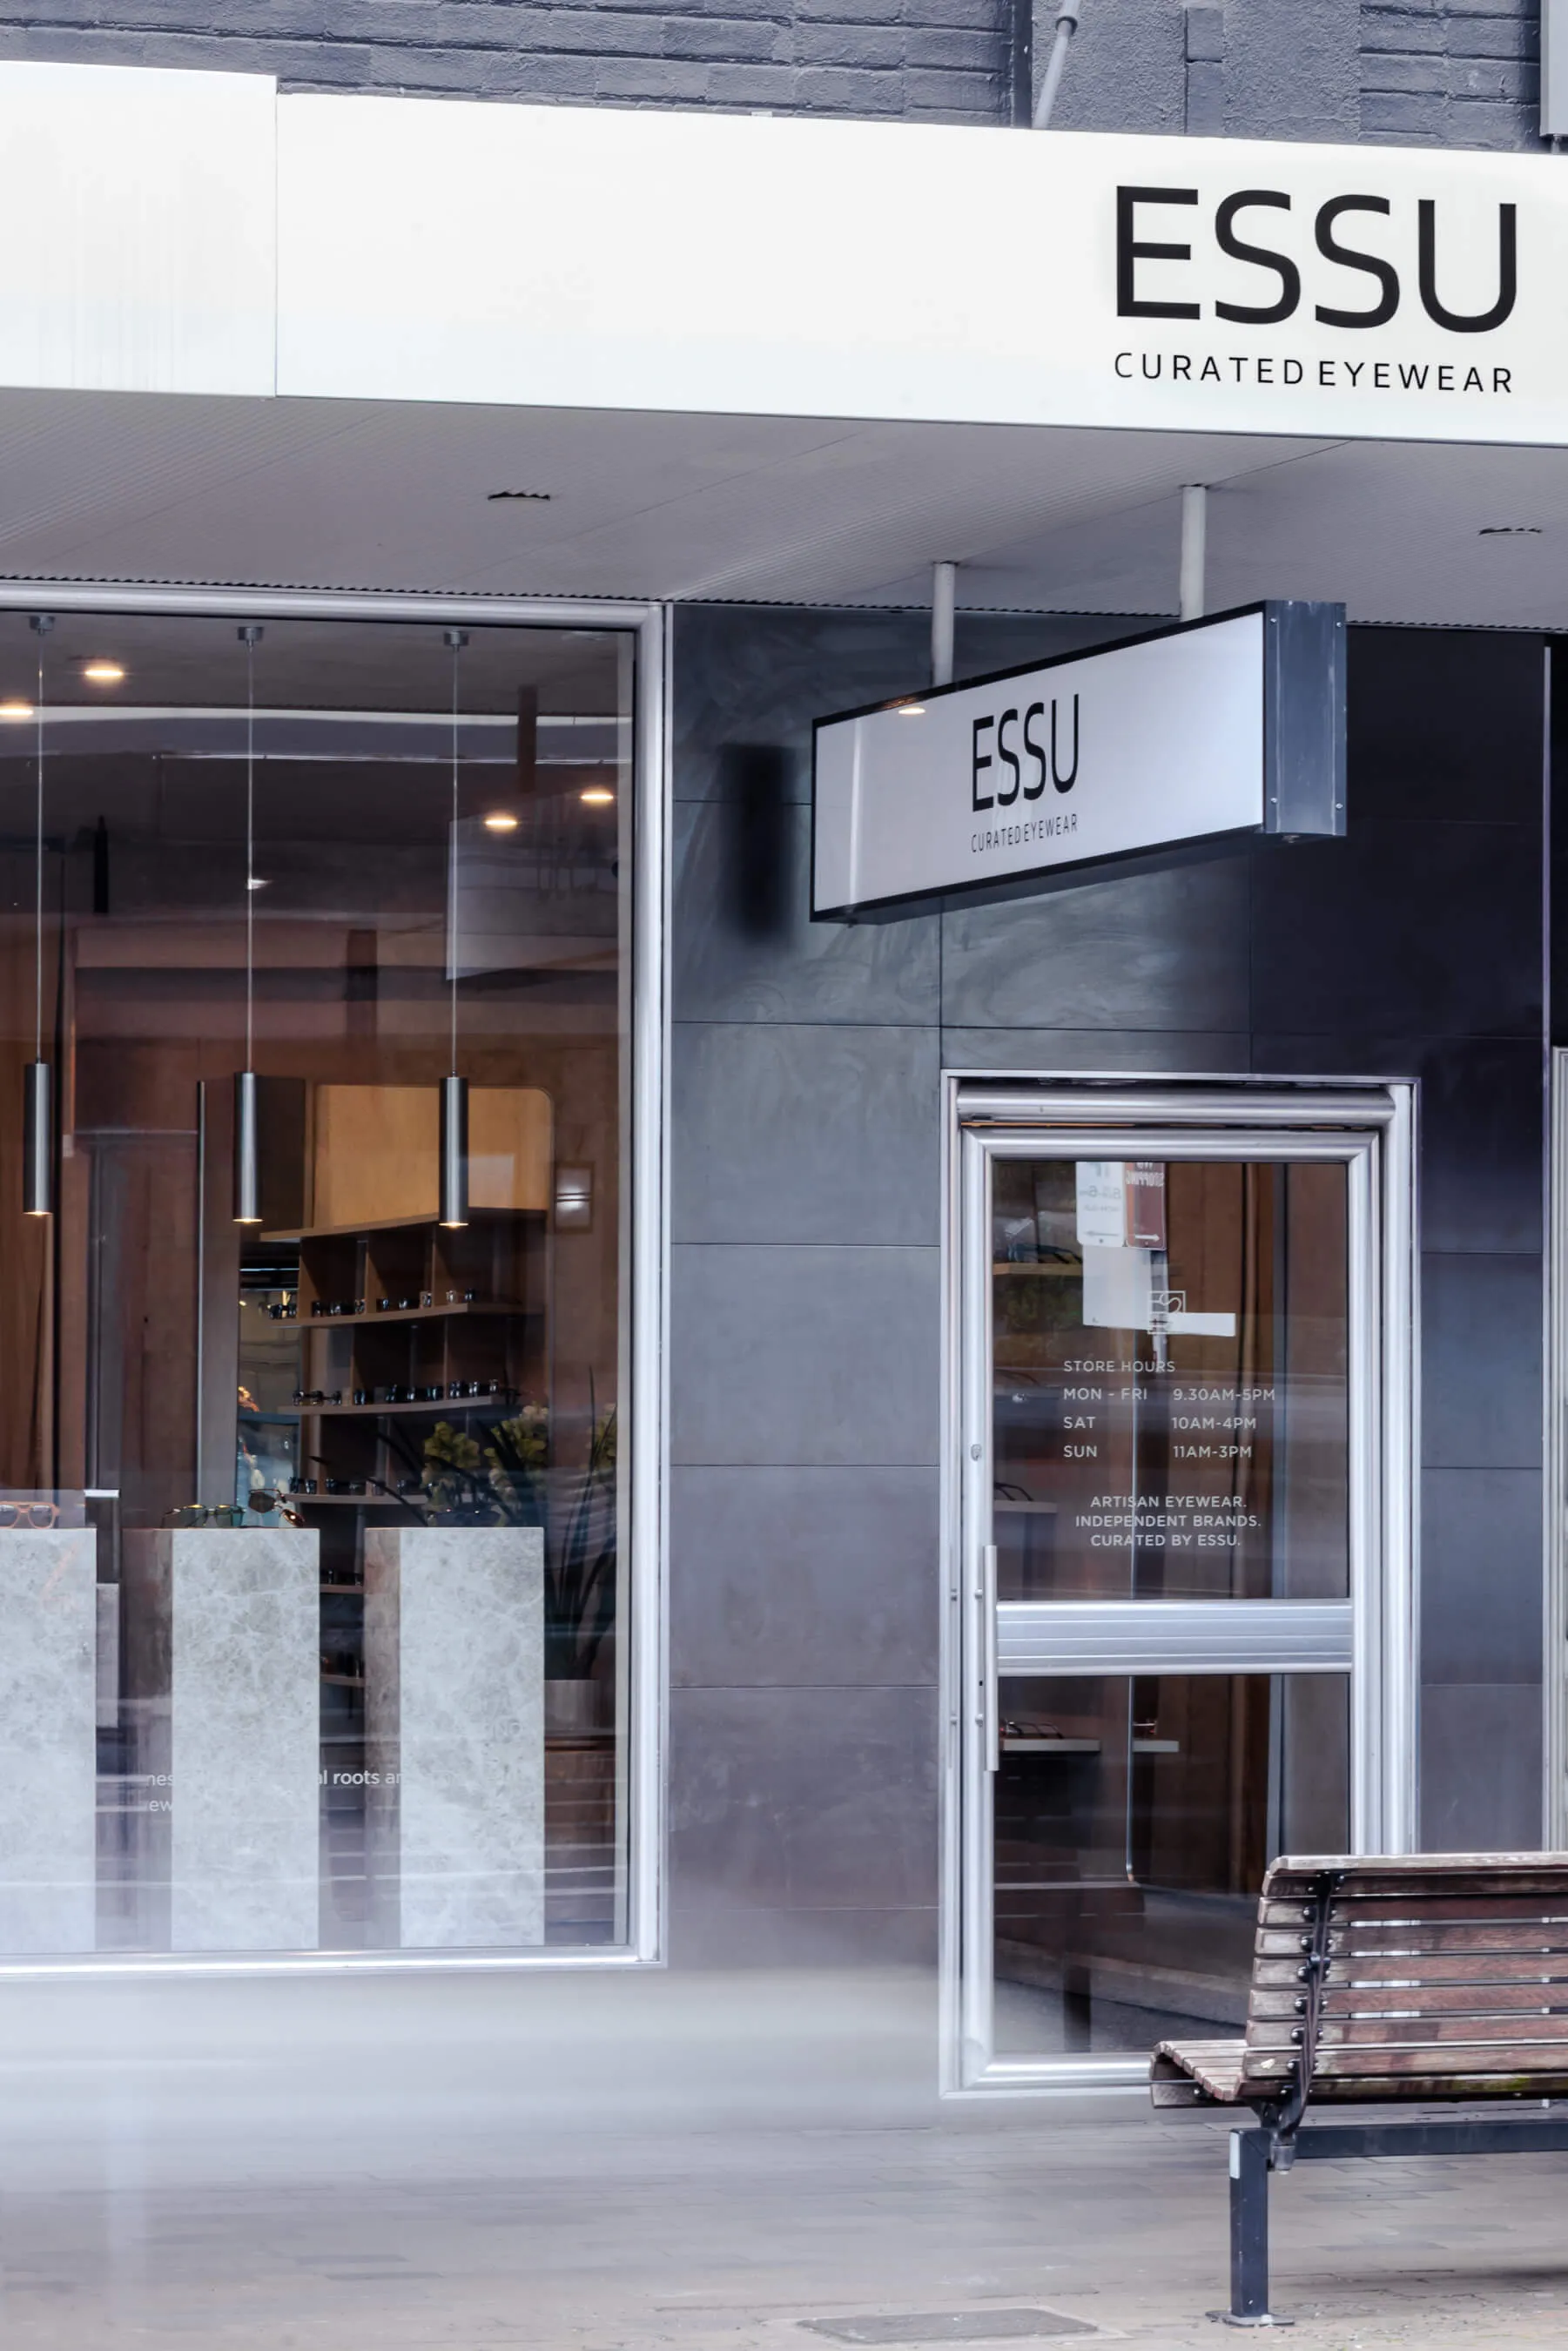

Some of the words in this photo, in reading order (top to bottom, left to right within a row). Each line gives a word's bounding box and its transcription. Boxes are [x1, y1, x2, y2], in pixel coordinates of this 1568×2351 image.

[1116, 185, 1517, 333] ESSU
[1114, 352, 1303, 385] CURATED
[1319, 360, 1511, 394] EYEWEAR
[972, 693, 1080, 812] ESSU
[971, 825, 1021, 853] CURATED
[1024, 813, 1078, 842] EYEWEAR
[1063, 1360, 1115, 1373] STORE
[1120, 1360, 1176, 1373] HOURS
[1063, 1387, 1102, 1400] MON
[1120, 1388, 1148, 1400] FRI
[1173, 1388, 1275, 1401] 9.30AM-5PM
[1063, 1416, 1096, 1429] SAT
[1172, 1417, 1256, 1429] 10AM-4PM
[1063, 1445, 1098, 1458] SUN
[1174, 1445, 1252, 1458] 11AM-3PM
[1090, 1496, 1160, 1508] ARTISAN
[1165, 1496, 1247, 1508] EYEWEAR.
[1075, 1515, 1187, 1527] INDEPENDENT
[1193, 1515, 1262, 1527] BRANDS.
[1090, 1534, 1166, 1546] CURATED
[1171, 1534, 1192, 1546] BY
[1197, 1534, 1241, 1546] ESSU.
[333, 1769, 380, 1785] roots
